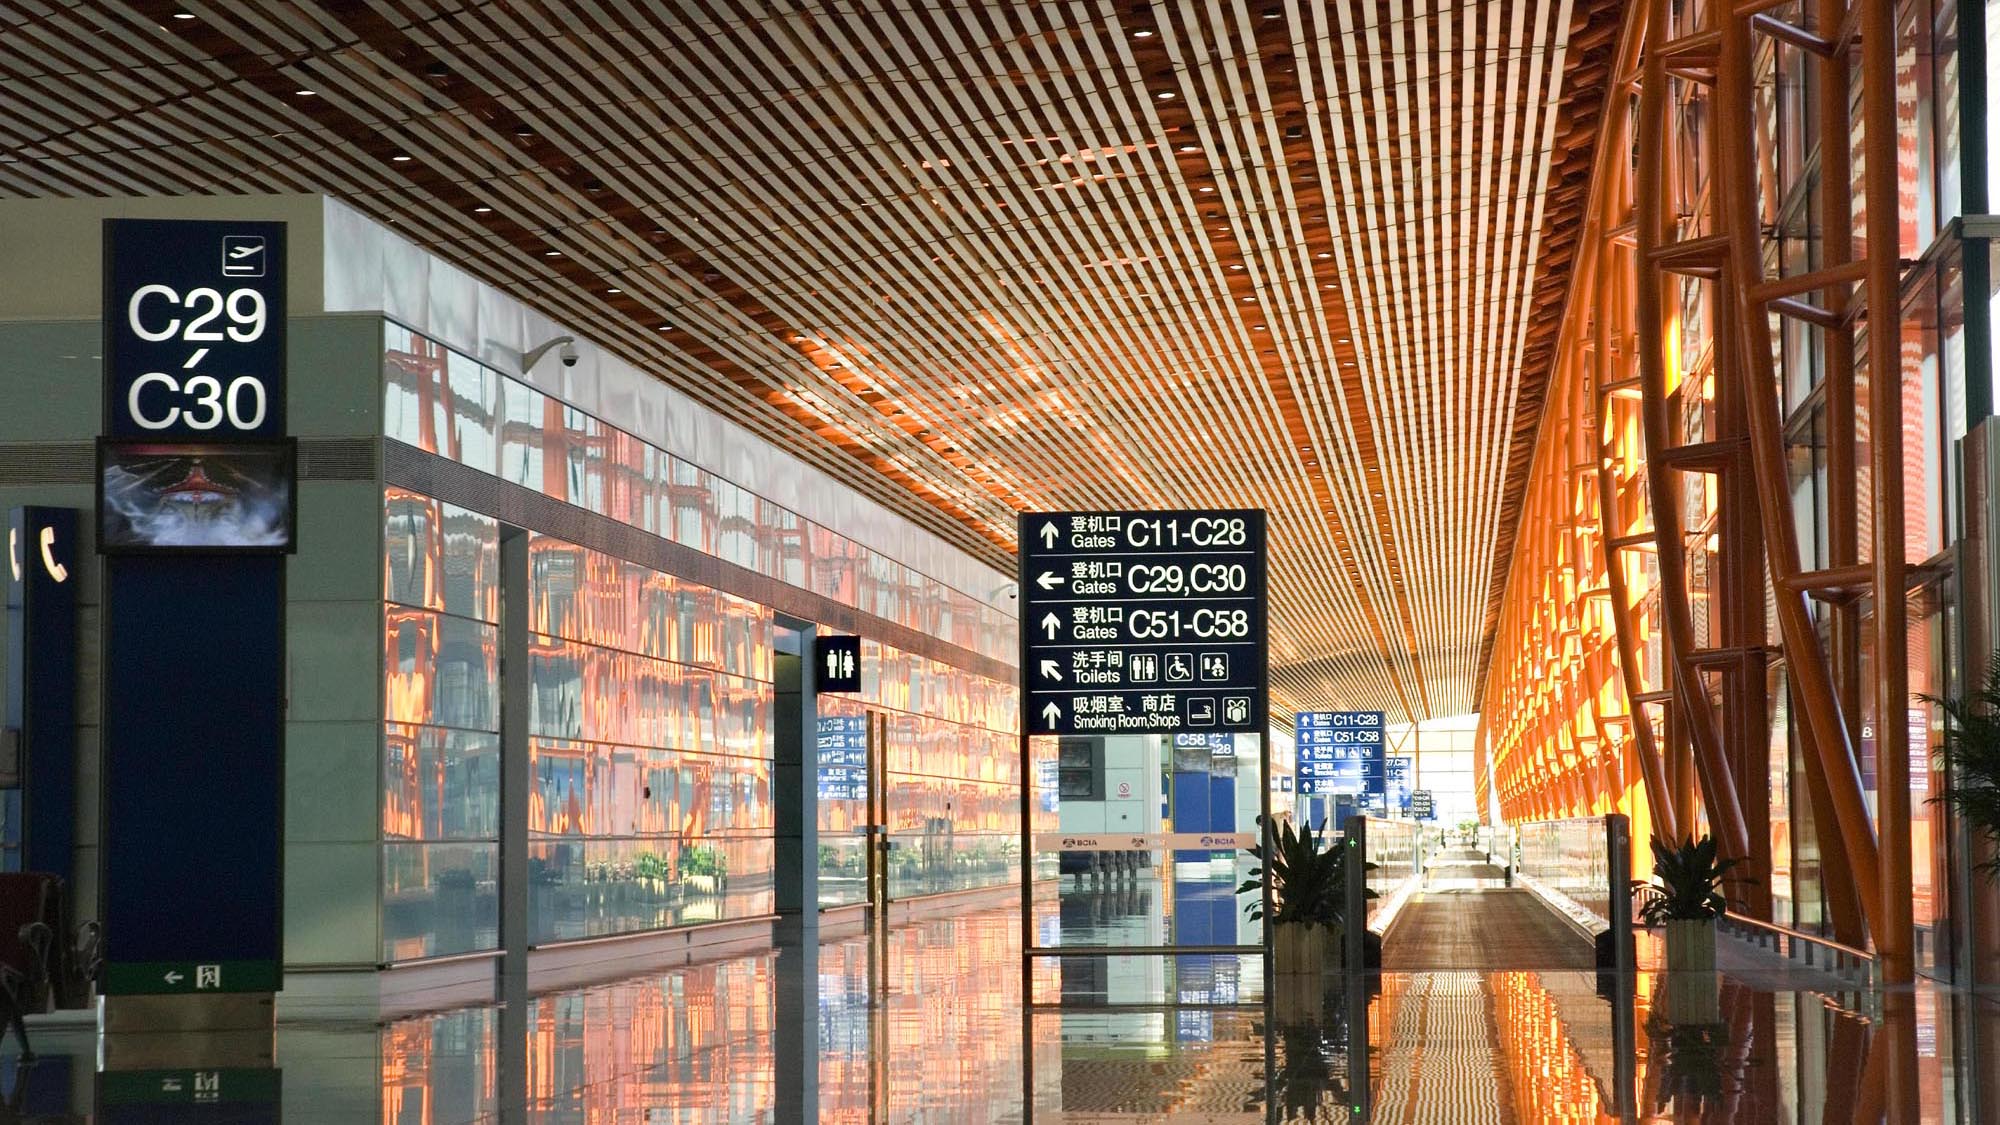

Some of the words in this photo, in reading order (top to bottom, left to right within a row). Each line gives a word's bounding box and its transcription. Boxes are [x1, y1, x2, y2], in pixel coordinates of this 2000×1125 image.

[129, 285, 267, 343] C29
[129, 373, 267, 430] C30
[1071, 516, 1121, 532] 登机口
[1127, 518, 1246, 547] C11-C28
[1072, 534, 1116, 548] Gates
[1072, 562, 1122, 578] 登机口
[1072, 580, 1117, 594] Gates
[1128, 564, 1246, 596] C29,C30
[1073, 607, 1123, 623] 登机口
[1073, 625, 1118, 639] Gates
[1129, 609, 1249, 639] C51-C58
[1073, 651, 1123, 668] 洗手间
[1073, 669, 1121, 683] Toilets
[1074, 714, 1117, 730] Smoking
[1333, 714, 1379, 726] C11-C28
[1177, 733, 1206, 746] C58
[1334, 730, 1380, 743] C51-C58
